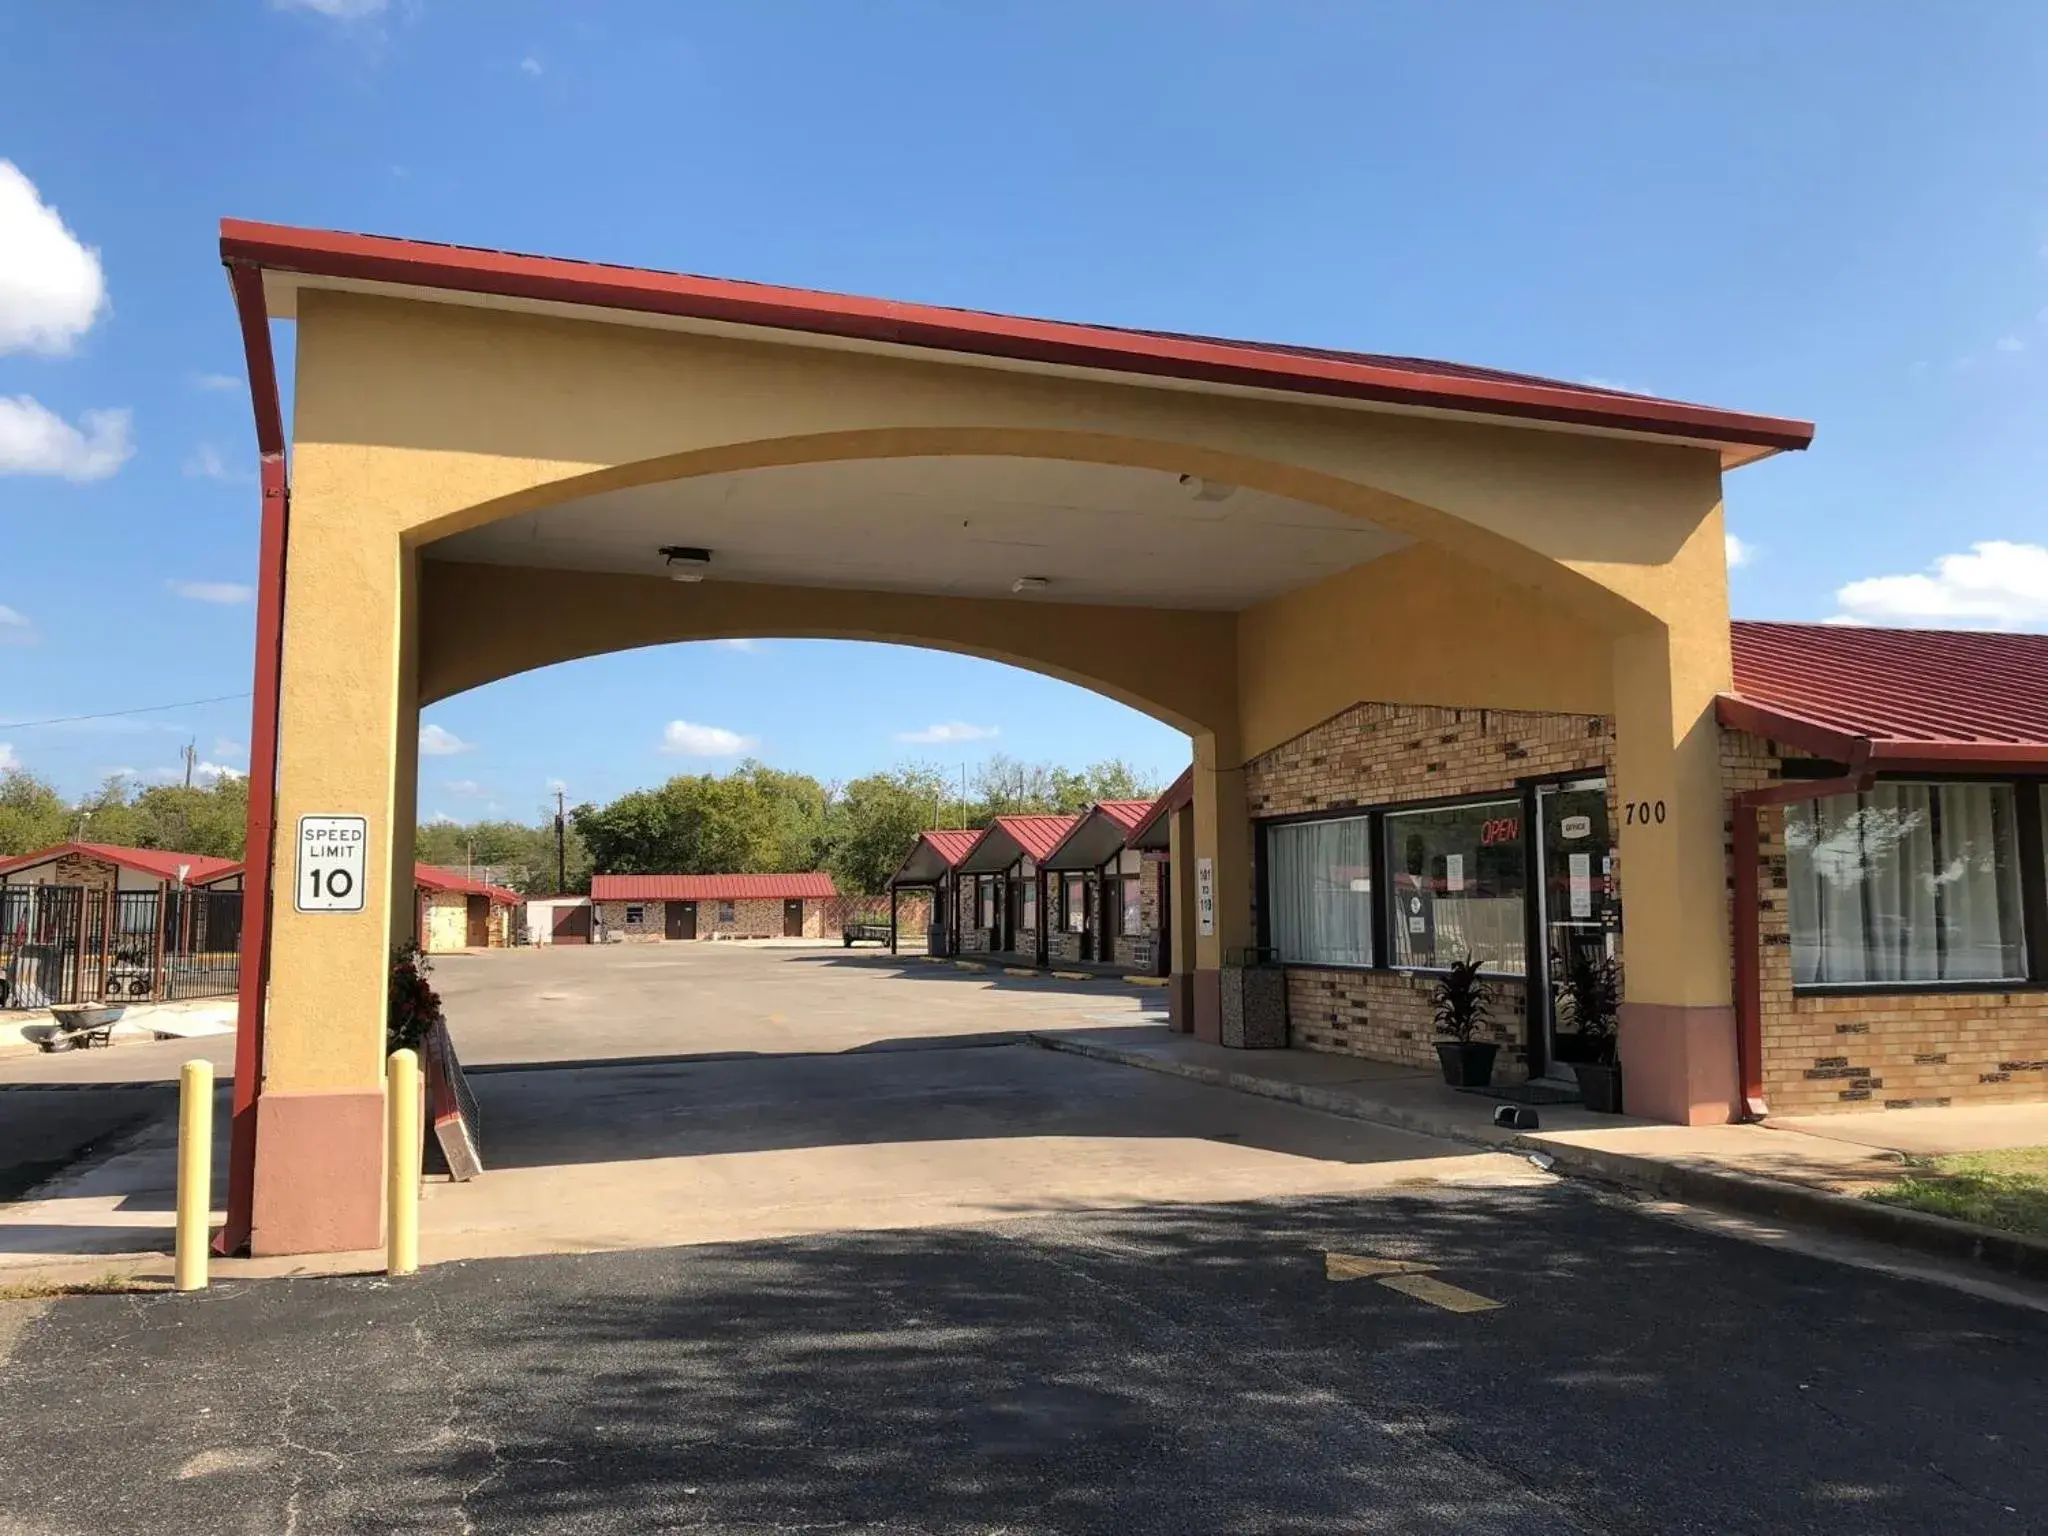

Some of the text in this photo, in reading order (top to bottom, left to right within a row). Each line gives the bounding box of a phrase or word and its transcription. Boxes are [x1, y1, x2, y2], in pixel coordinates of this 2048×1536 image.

[1625, 800, 1665, 825] 700
[305, 829, 361, 841] SPEED
[1481, 818, 1518, 845] OPEN
[310, 845, 355, 858] LIMIT
[309, 868, 353, 898] 10
